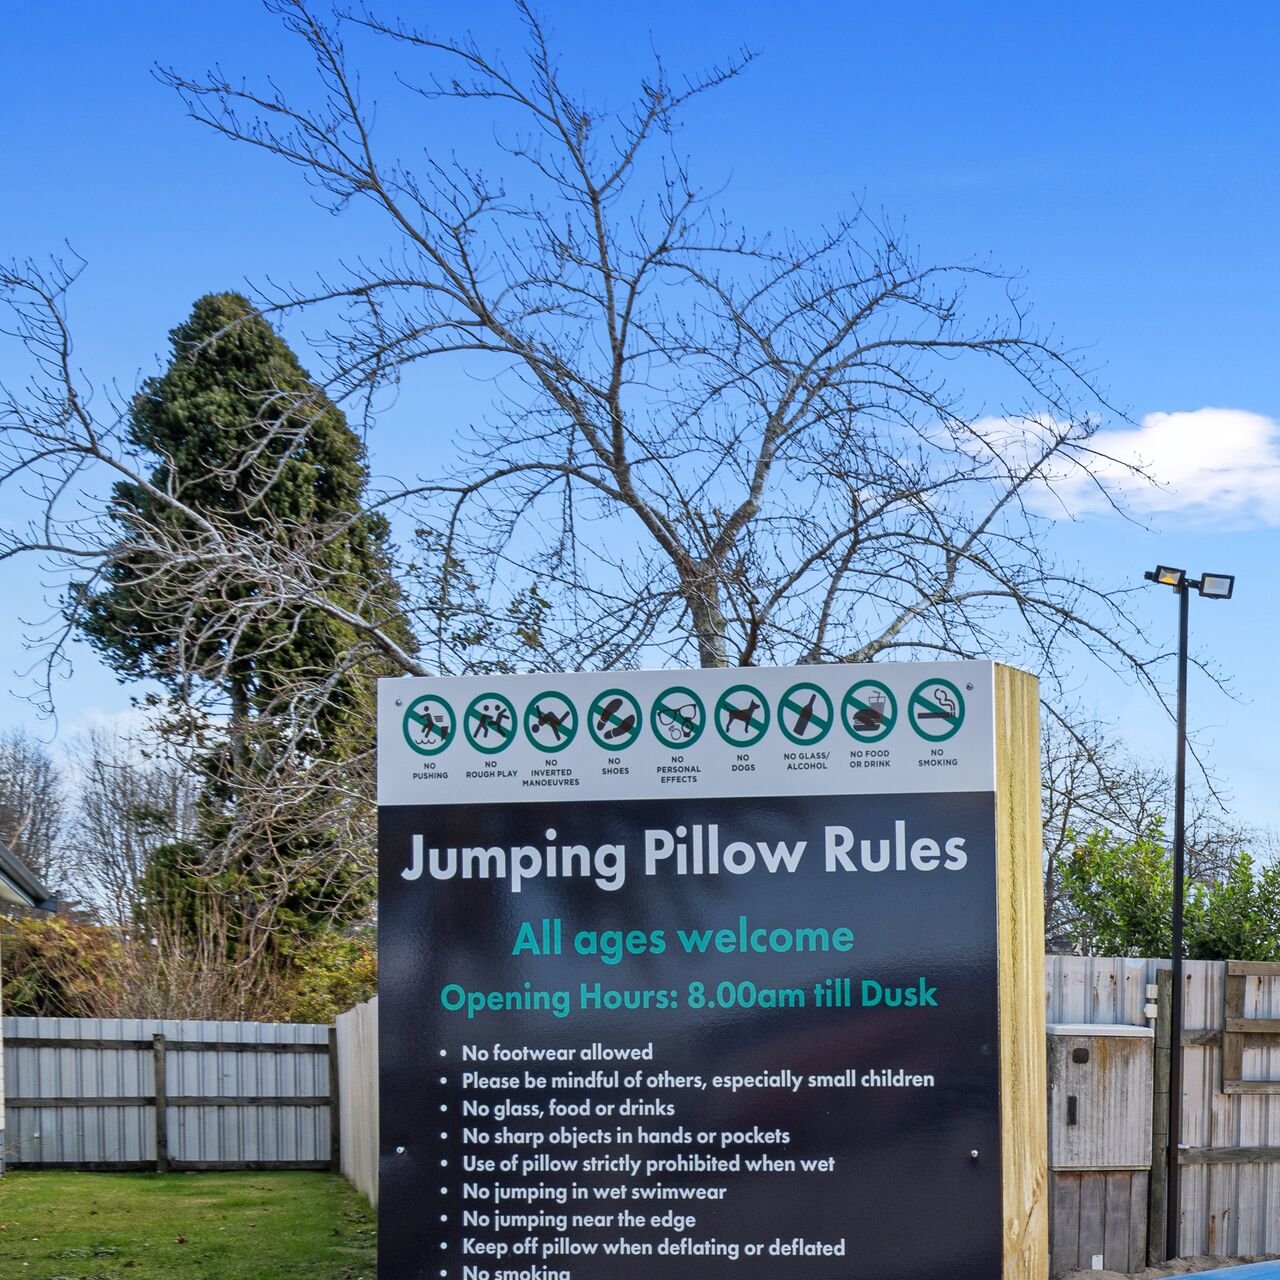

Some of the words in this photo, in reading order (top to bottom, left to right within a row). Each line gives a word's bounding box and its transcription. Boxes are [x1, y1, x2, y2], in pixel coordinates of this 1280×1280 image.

[783, 752, 797, 761] NO
[798, 751, 831, 760] GLASS/
[850, 750, 864, 758] NO
[864, 749, 890, 758] FOOD
[930, 748, 944, 757] NO
[608, 757, 621, 765] NO
[671, 755, 684, 764] NO
[736, 754, 750, 762] NO
[918, 758, 958, 767] SMOKING
[423, 762, 437, 770] NO
[484, 760, 498, 769] NO
[544, 759, 558, 768] NO
[731, 763, 756, 772] DOGS
[786, 762, 828, 771] ALCOHOL
[849, 760, 862, 769] OR
[863, 759, 891, 768] DRINK
[530, 768, 574, 777] INVERTED
[601, 767, 630, 776] SHOES
[656, 765, 702, 774] PERSONAL
[412, 771, 449, 780] PUSHING
[465, 770, 496, 779] ROUGH
[496, 770, 518, 778] PLAY
[522, 778, 580, 787] MANOEUVRES
[660, 775, 698, 784] EFFECTS
[400, 828, 626, 891] Jumping
[644, 823, 808, 876] Pillow
[824, 819, 968, 873] Rules
[511, 918, 562, 956] All
[574, 929, 667, 965] ages
[676, 915, 855, 954] welcome
[440, 981, 571, 1019] Opening
[579, 979, 679, 1010] Hours:
[687, 980, 805, 1009] 8.00am
[813, 977, 851, 1007] till
[861, 976, 938, 1007] Dusk
[462, 1044, 490, 1062] No
[492, 1043, 577, 1061] footwear
[580, 1042, 653, 1061] allowed
[462, 1071, 521, 1089] Please
[524, 1070, 547, 1089] be
[551, 1070, 619, 1089] mindful
[623, 1069, 643, 1089] of
[646, 1069, 707, 1091] others,
[711, 1069, 804, 1093] especially
[807, 1069, 856, 1088] small
[860, 1068, 935, 1088] children
[462, 1099, 490, 1117] No
[493, 1098, 545, 1121] glass,
[548, 1098, 591, 1117] food
[594, 1104, 616, 1117] or
[618, 1097, 676, 1116] drinks
[463, 1127, 490, 1144] No
[494, 1126, 545, 1149] sharp
[548, 1125, 612, 1149] objects
[616, 1126, 633, 1144] in
[637, 1125, 693, 1144] hands
[696, 1131, 718, 1144] or
[720, 1125, 791, 1149] pockets
[463, 1155, 496, 1172] Use
[499, 1153, 519, 1172] of
[522, 1153, 579, 1177] pillow
[582, 1153, 642, 1177] strictly
[646, 1153, 741, 1177] prohibited
[744, 1153, 796, 1172] when
[799, 1156, 836, 1172] wet
[463, 1182, 490, 1200] No
[494, 1181, 568, 1204] jumping
[572, 1181, 589, 1200] in
[592, 1184, 628, 1200] wet
[631, 1181, 728, 1200] swimwear
[463, 1210, 490, 1227] No
[494, 1209, 568, 1232] jumping
[572, 1215, 615, 1228] near
[617, 1209, 646, 1228] the
[650, 1209, 697, 1233] edge
[463, 1237, 509, 1259] Keep
[512, 1236, 539, 1255] off
[542, 1236, 599, 1260] pillow
[602, 1237, 653, 1256] when
[657, 1237, 740, 1261] deflating
[743, 1243, 765, 1256] or
[768, 1237, 846, 1257] deflated
